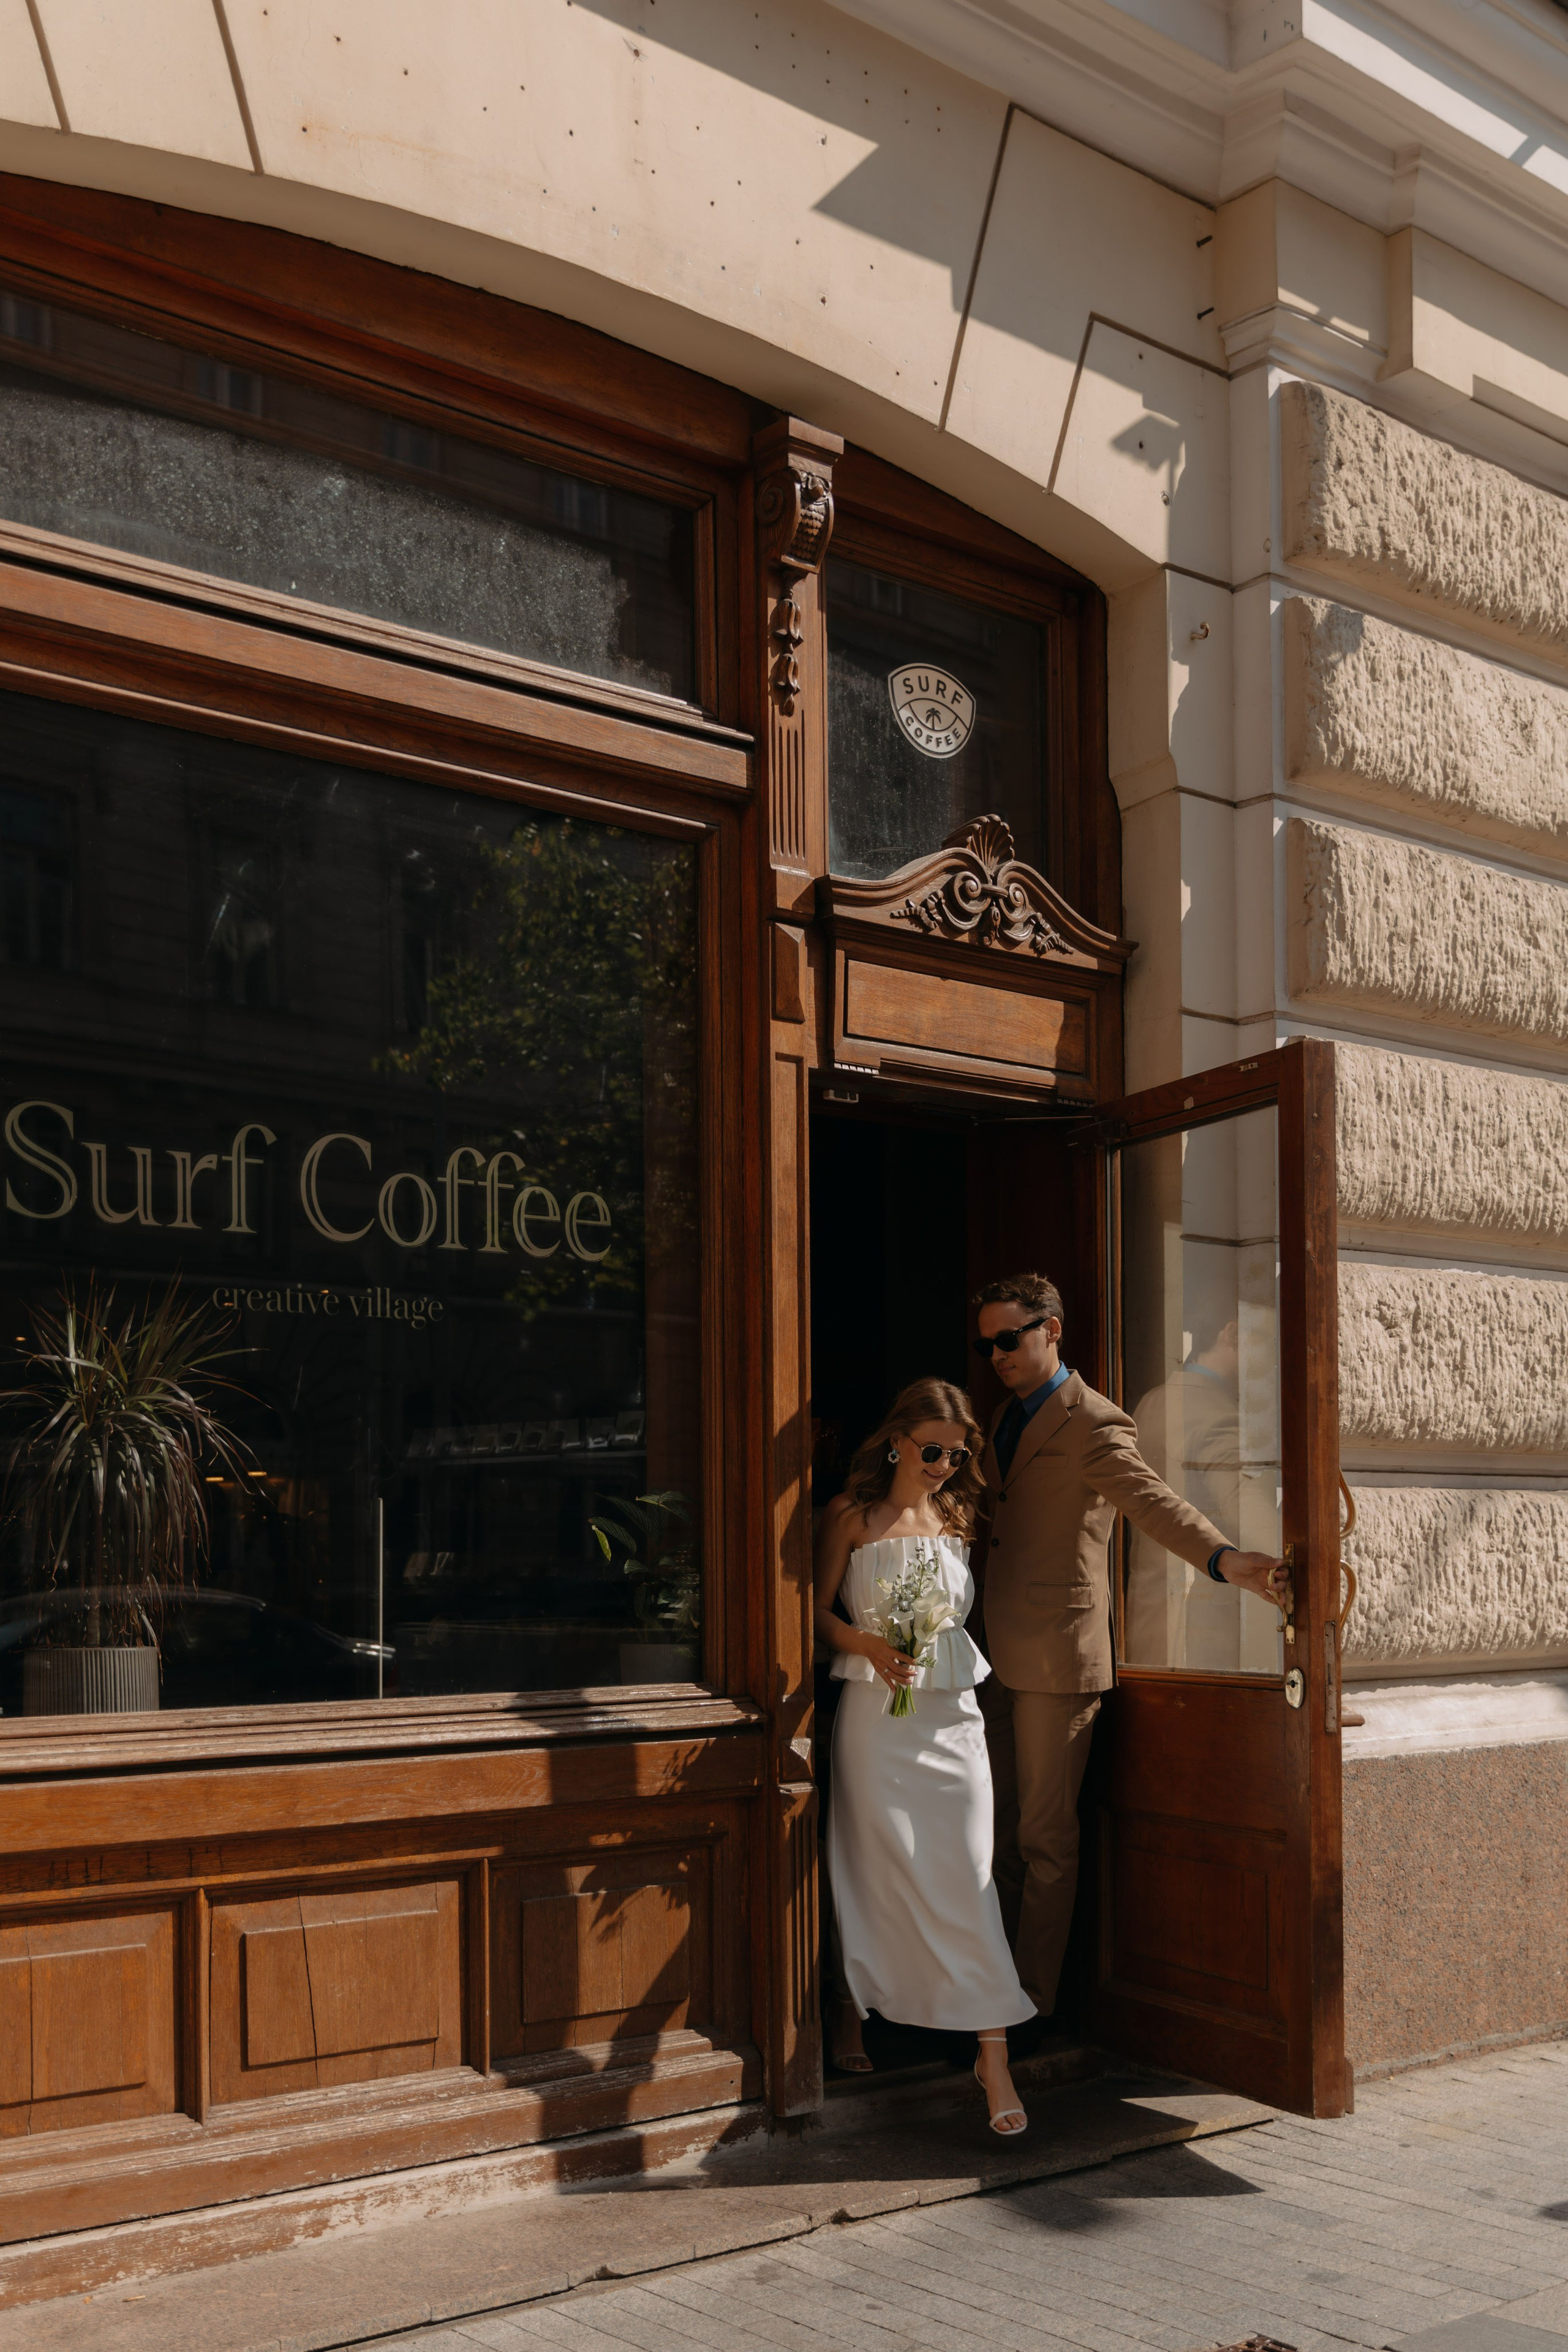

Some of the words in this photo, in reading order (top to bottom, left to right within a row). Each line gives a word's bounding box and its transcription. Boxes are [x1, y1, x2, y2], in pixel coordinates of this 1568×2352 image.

[902, 676, 963, 705] SURF
[905, 716, 961, 748] COFFEE
[4, 1100, 277, 1234] Surf
[300, 1133, 612, 1262] Coffee
[212, 1283, 340, 1316] creative
[348, 1286, 443, 1330] village
